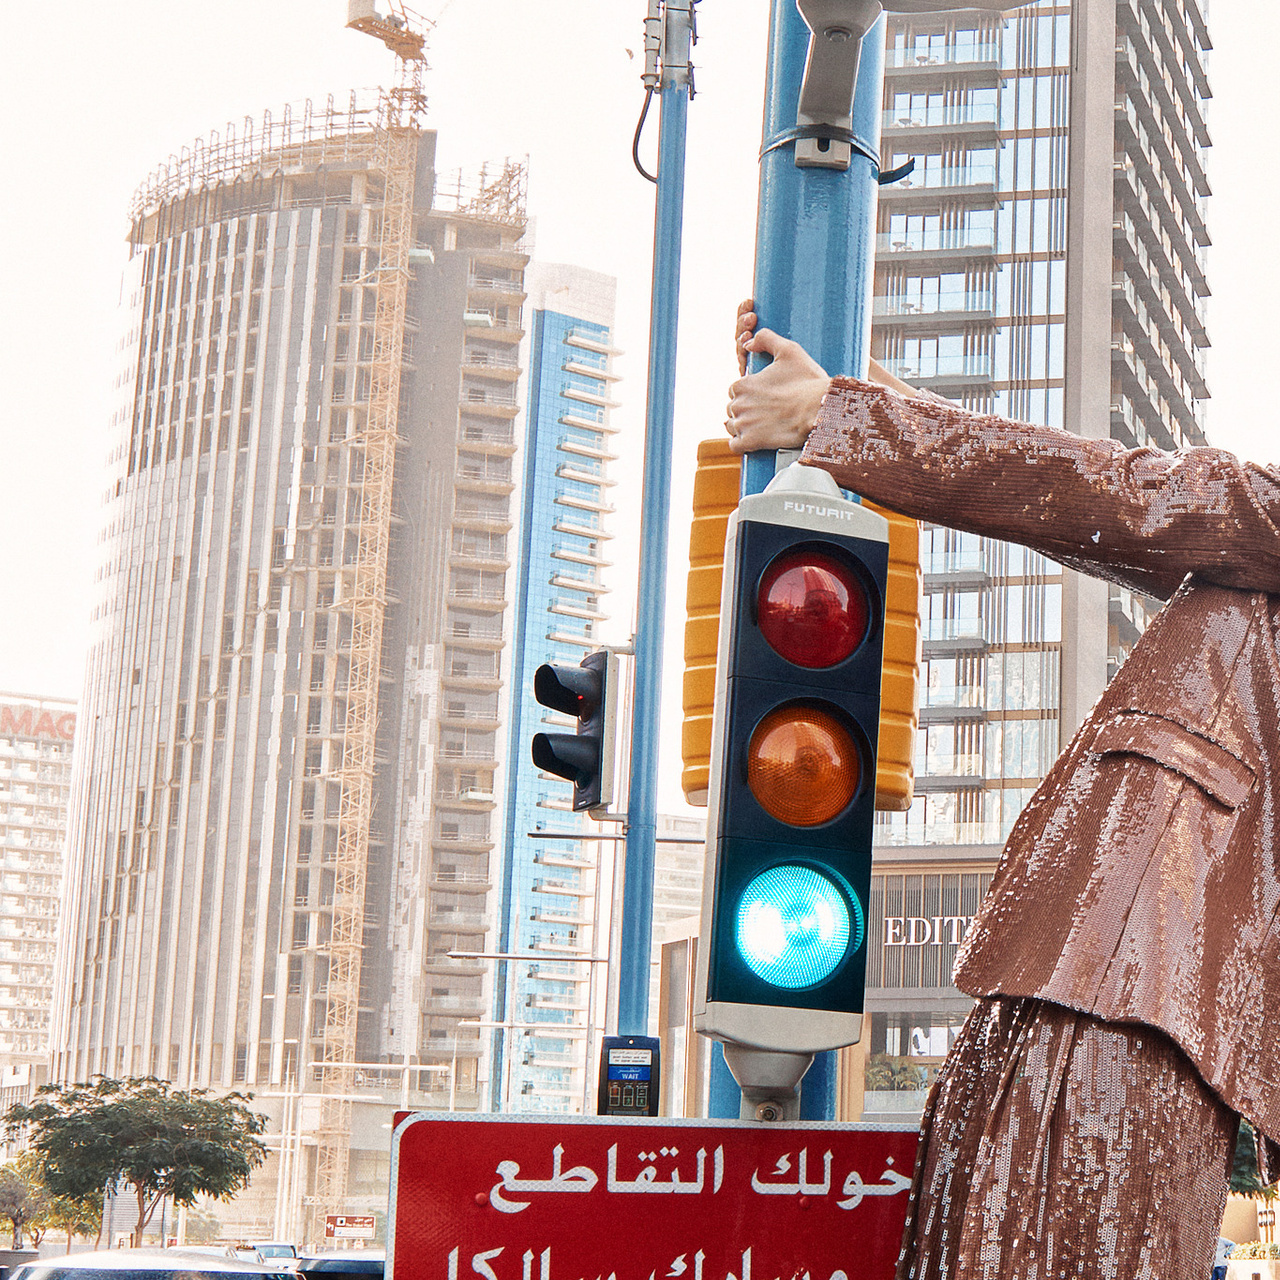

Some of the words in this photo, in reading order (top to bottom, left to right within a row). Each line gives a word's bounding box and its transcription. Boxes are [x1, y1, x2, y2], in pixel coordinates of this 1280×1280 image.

[784, 501, 854, 520] FUTURIT
[884, 916, 974, 946] EDIT
[490, 1143, 724, 1213] التقاطع
[752, 1148, 911, 1209] خولك
